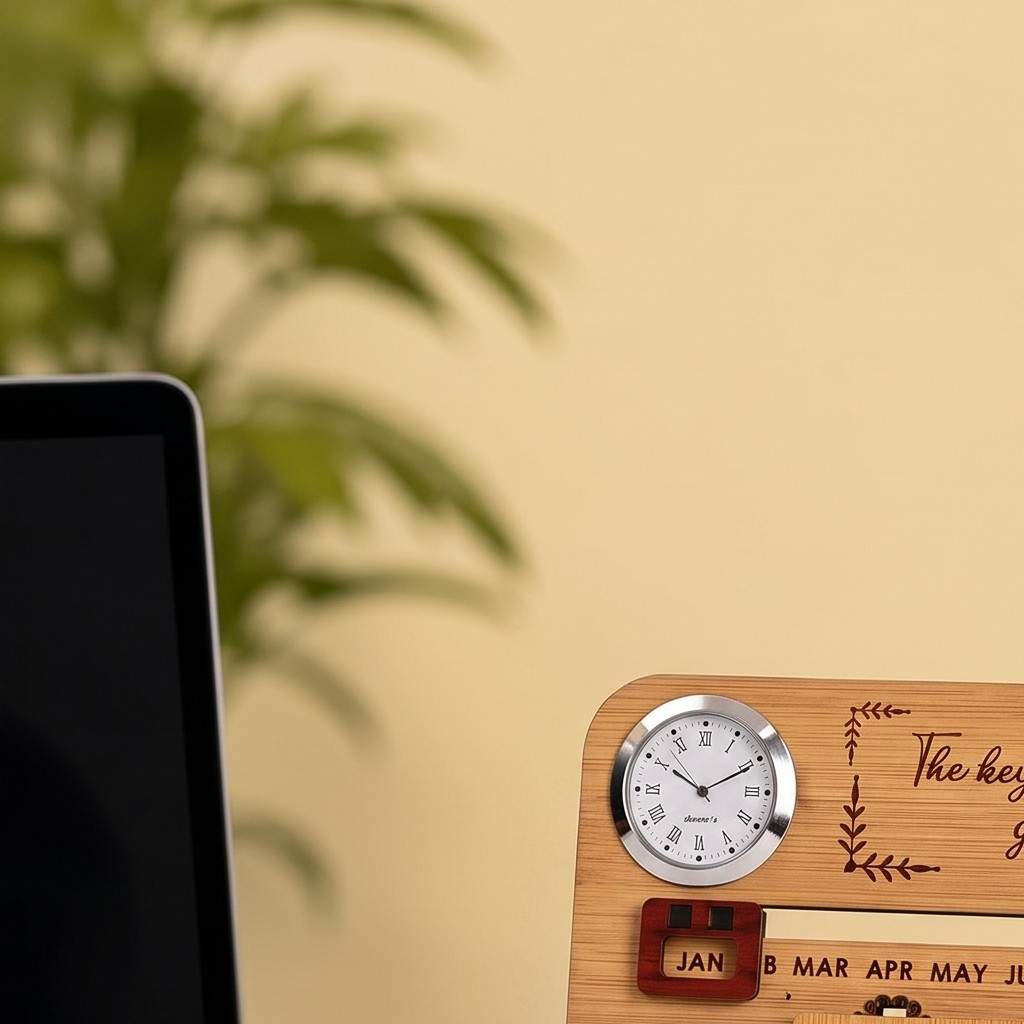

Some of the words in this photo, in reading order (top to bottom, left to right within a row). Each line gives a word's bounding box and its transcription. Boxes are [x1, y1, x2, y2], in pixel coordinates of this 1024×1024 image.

[912, 732, 969, 787] The
[677, 952, 723, 972] JAN
[793, 957, 848, 977] MAR
[866, 960, 912, 980] APR
[930, 963, 987, 983] MAY
